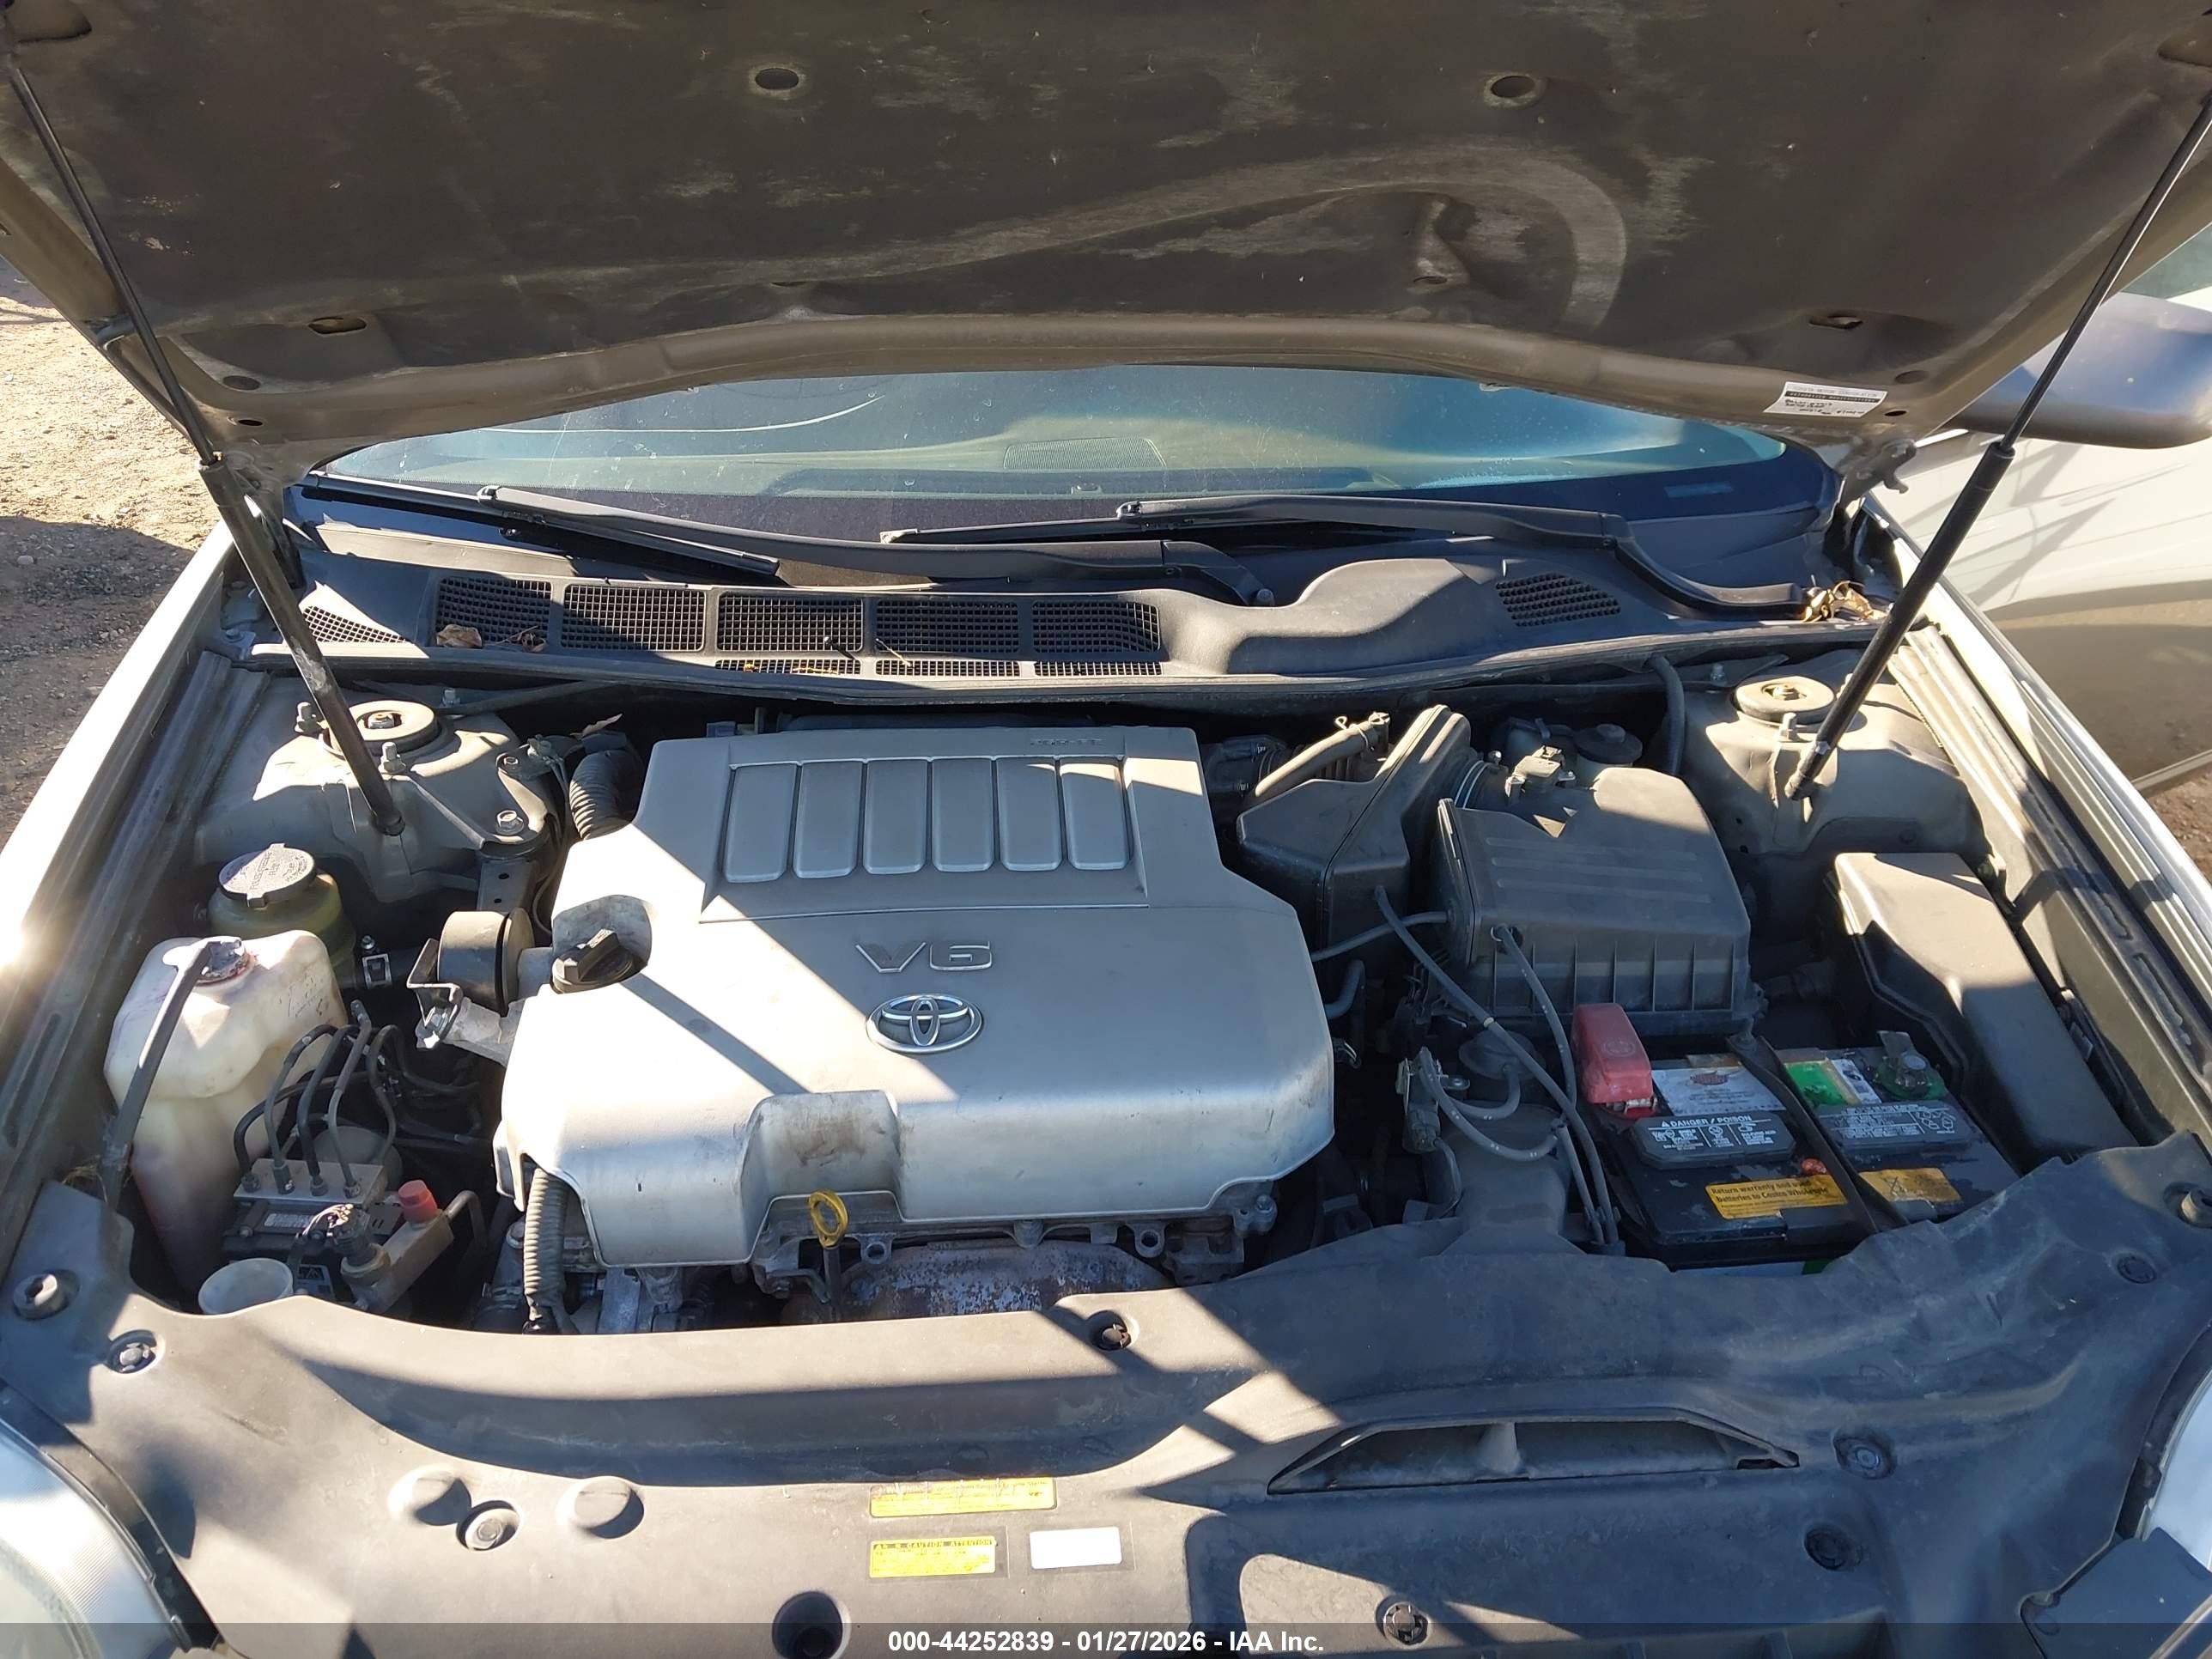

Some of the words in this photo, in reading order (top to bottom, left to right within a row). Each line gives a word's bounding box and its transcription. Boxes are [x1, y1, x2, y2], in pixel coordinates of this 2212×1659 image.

[855, 940, 993, 973] V6
[1669, 1118, 1709, 1127] DANGER
[1711, 1185, 1739, 1194] Return
[1740, 1182, 1775, 1194] warranty
[1717, 1194, 1751, 1203] batteries
